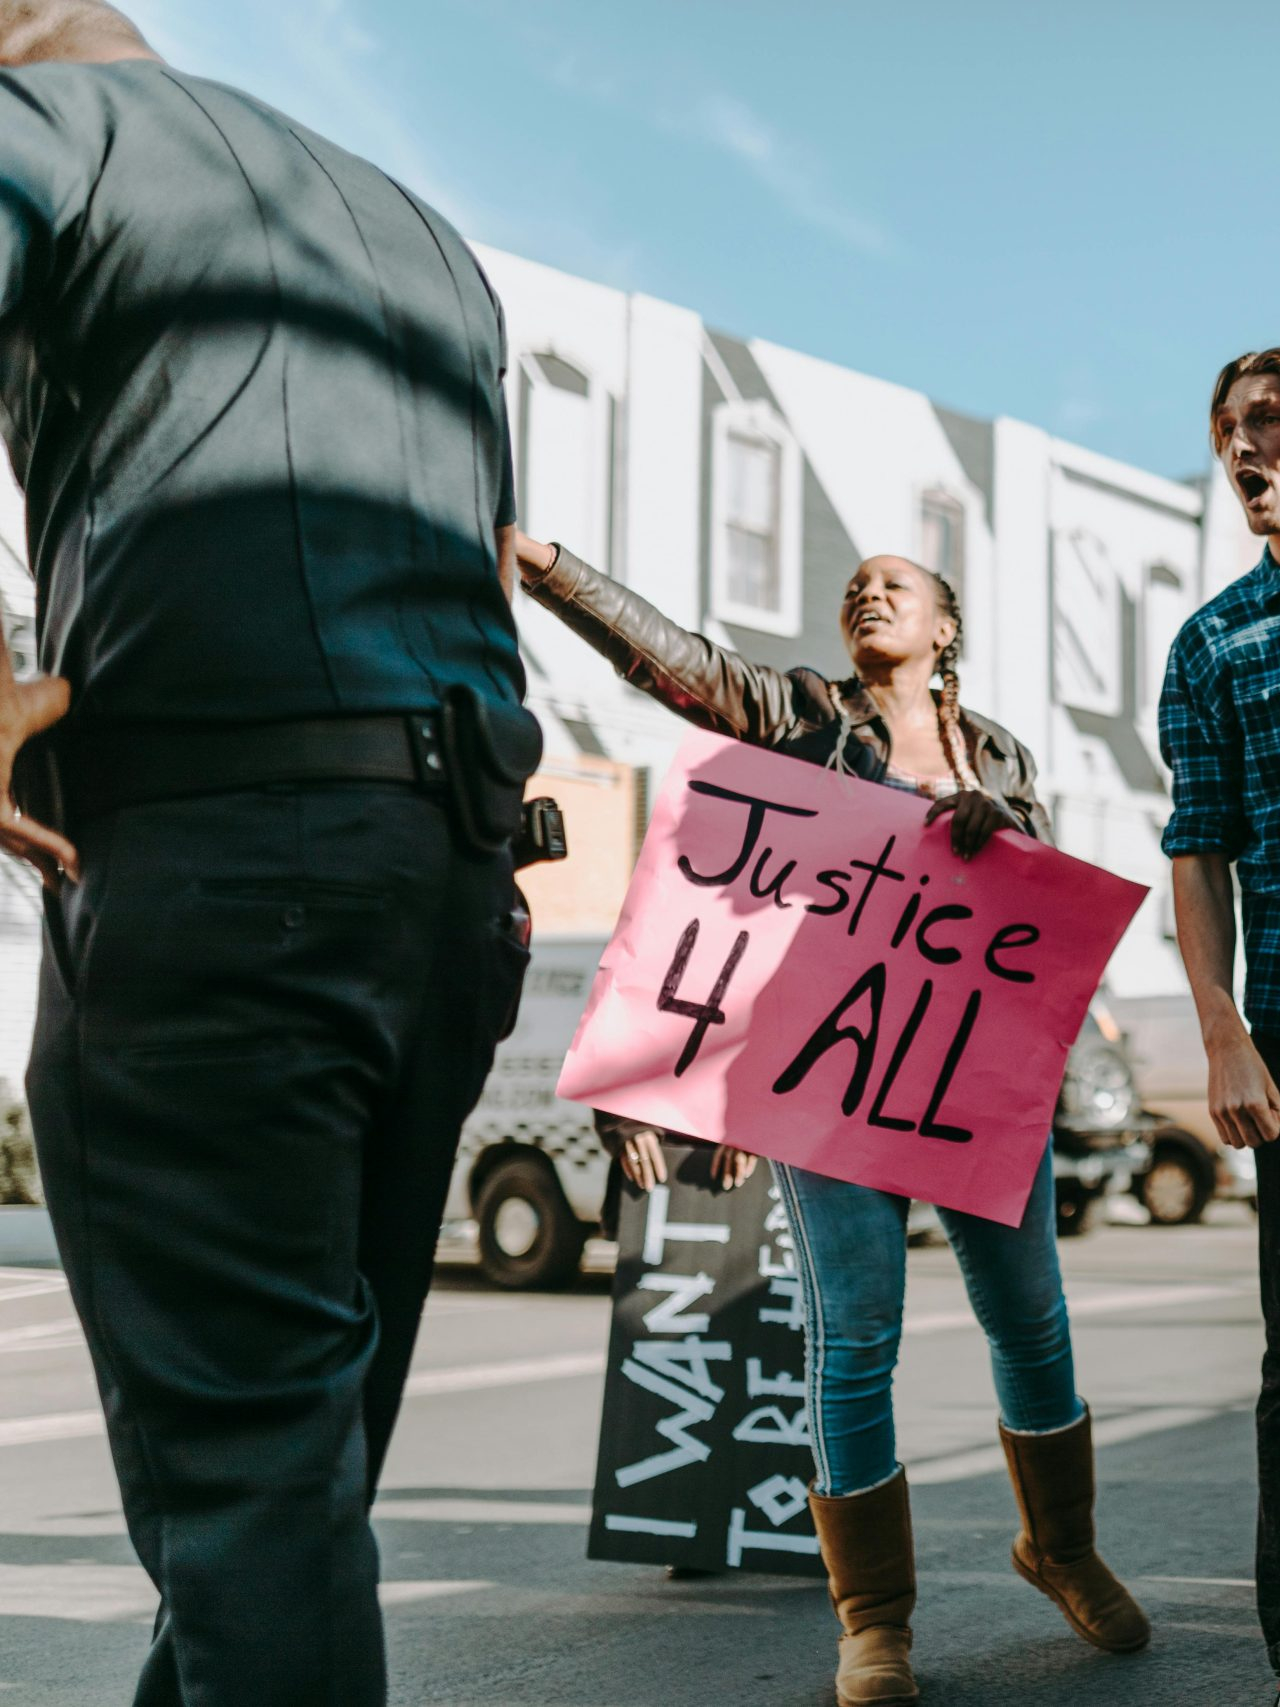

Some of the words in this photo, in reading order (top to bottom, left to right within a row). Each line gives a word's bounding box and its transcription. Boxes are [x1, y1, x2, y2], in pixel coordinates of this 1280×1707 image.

[677, 780, 1040, 984] Justice
[656, 918, 750, 1078] 4
[772, 962, 982, 1143] ALL
[615, 1183, 732, 1489] WANT
[605, 1513, 697, 1538] I
[725, 1474, 821, 1568] TO
